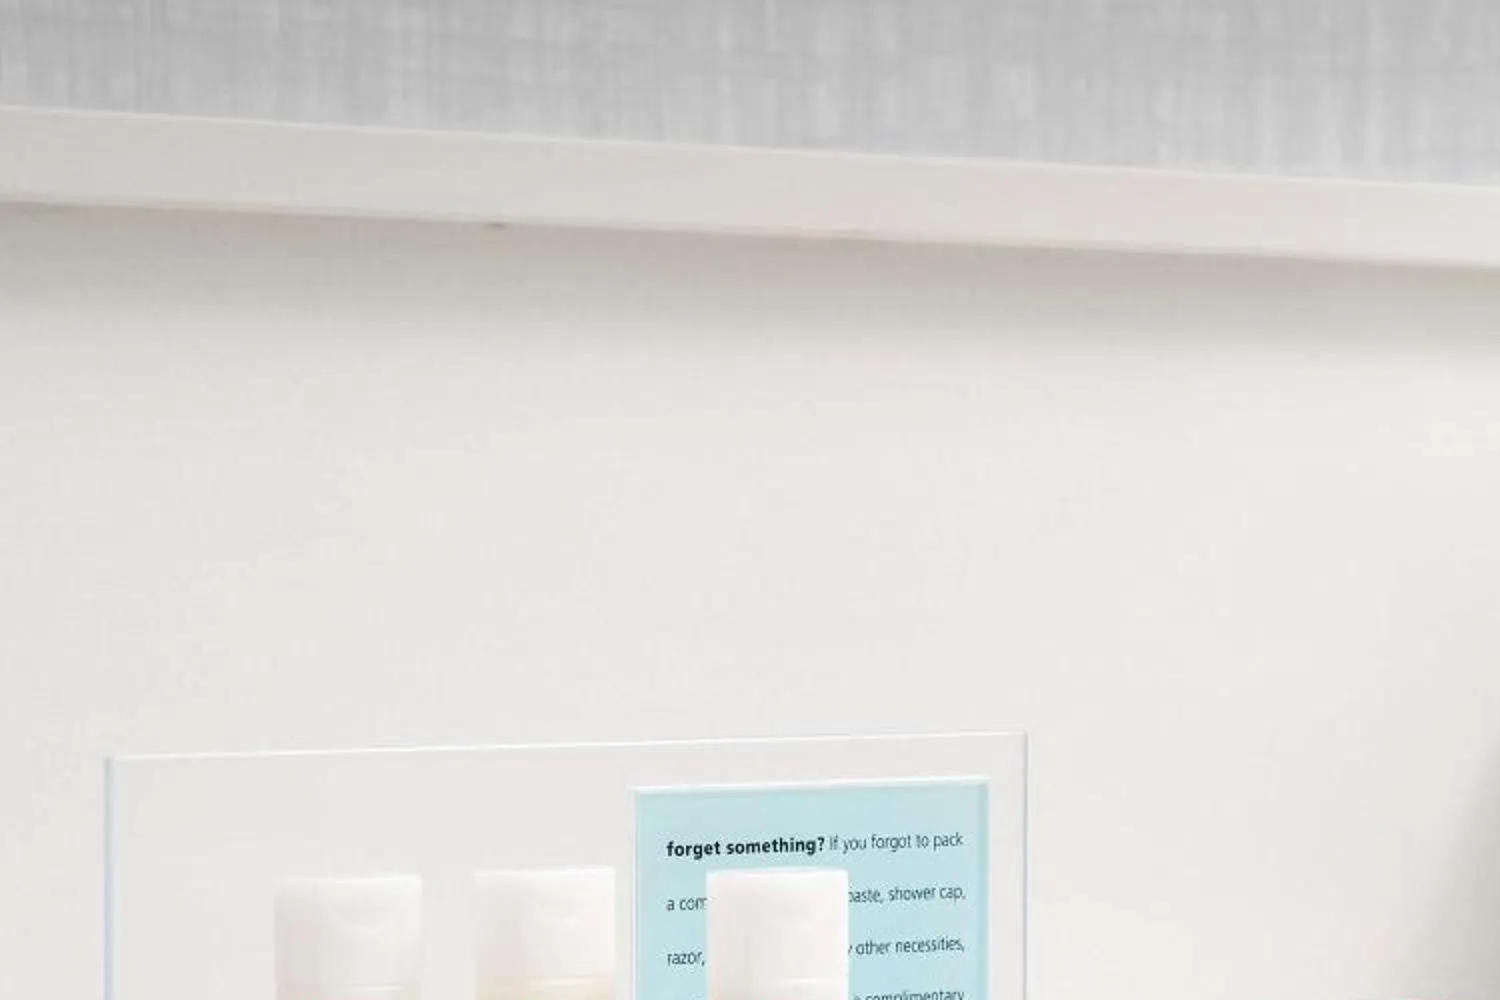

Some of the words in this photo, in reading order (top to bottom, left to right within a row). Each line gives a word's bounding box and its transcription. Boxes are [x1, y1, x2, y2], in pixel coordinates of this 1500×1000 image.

[667, 840, 720, 860] forget
[726, 836, 825, 856] something?
[829, 835, 839, 850] If
[842, 838, 867, 855] you
[871, 833, 912, 853] forgot
[915, 834, 930, 849] to
[933, 831, 963, 851] pack
[666, 899, 675, 911] a
[888, 886, 937, 902] shower
[939, 885, 966, 903] cap,
[667, 951, 705, 967] razor,
[855, 939, 891, 956] other
[895, 936, 965, 953] necessities,
